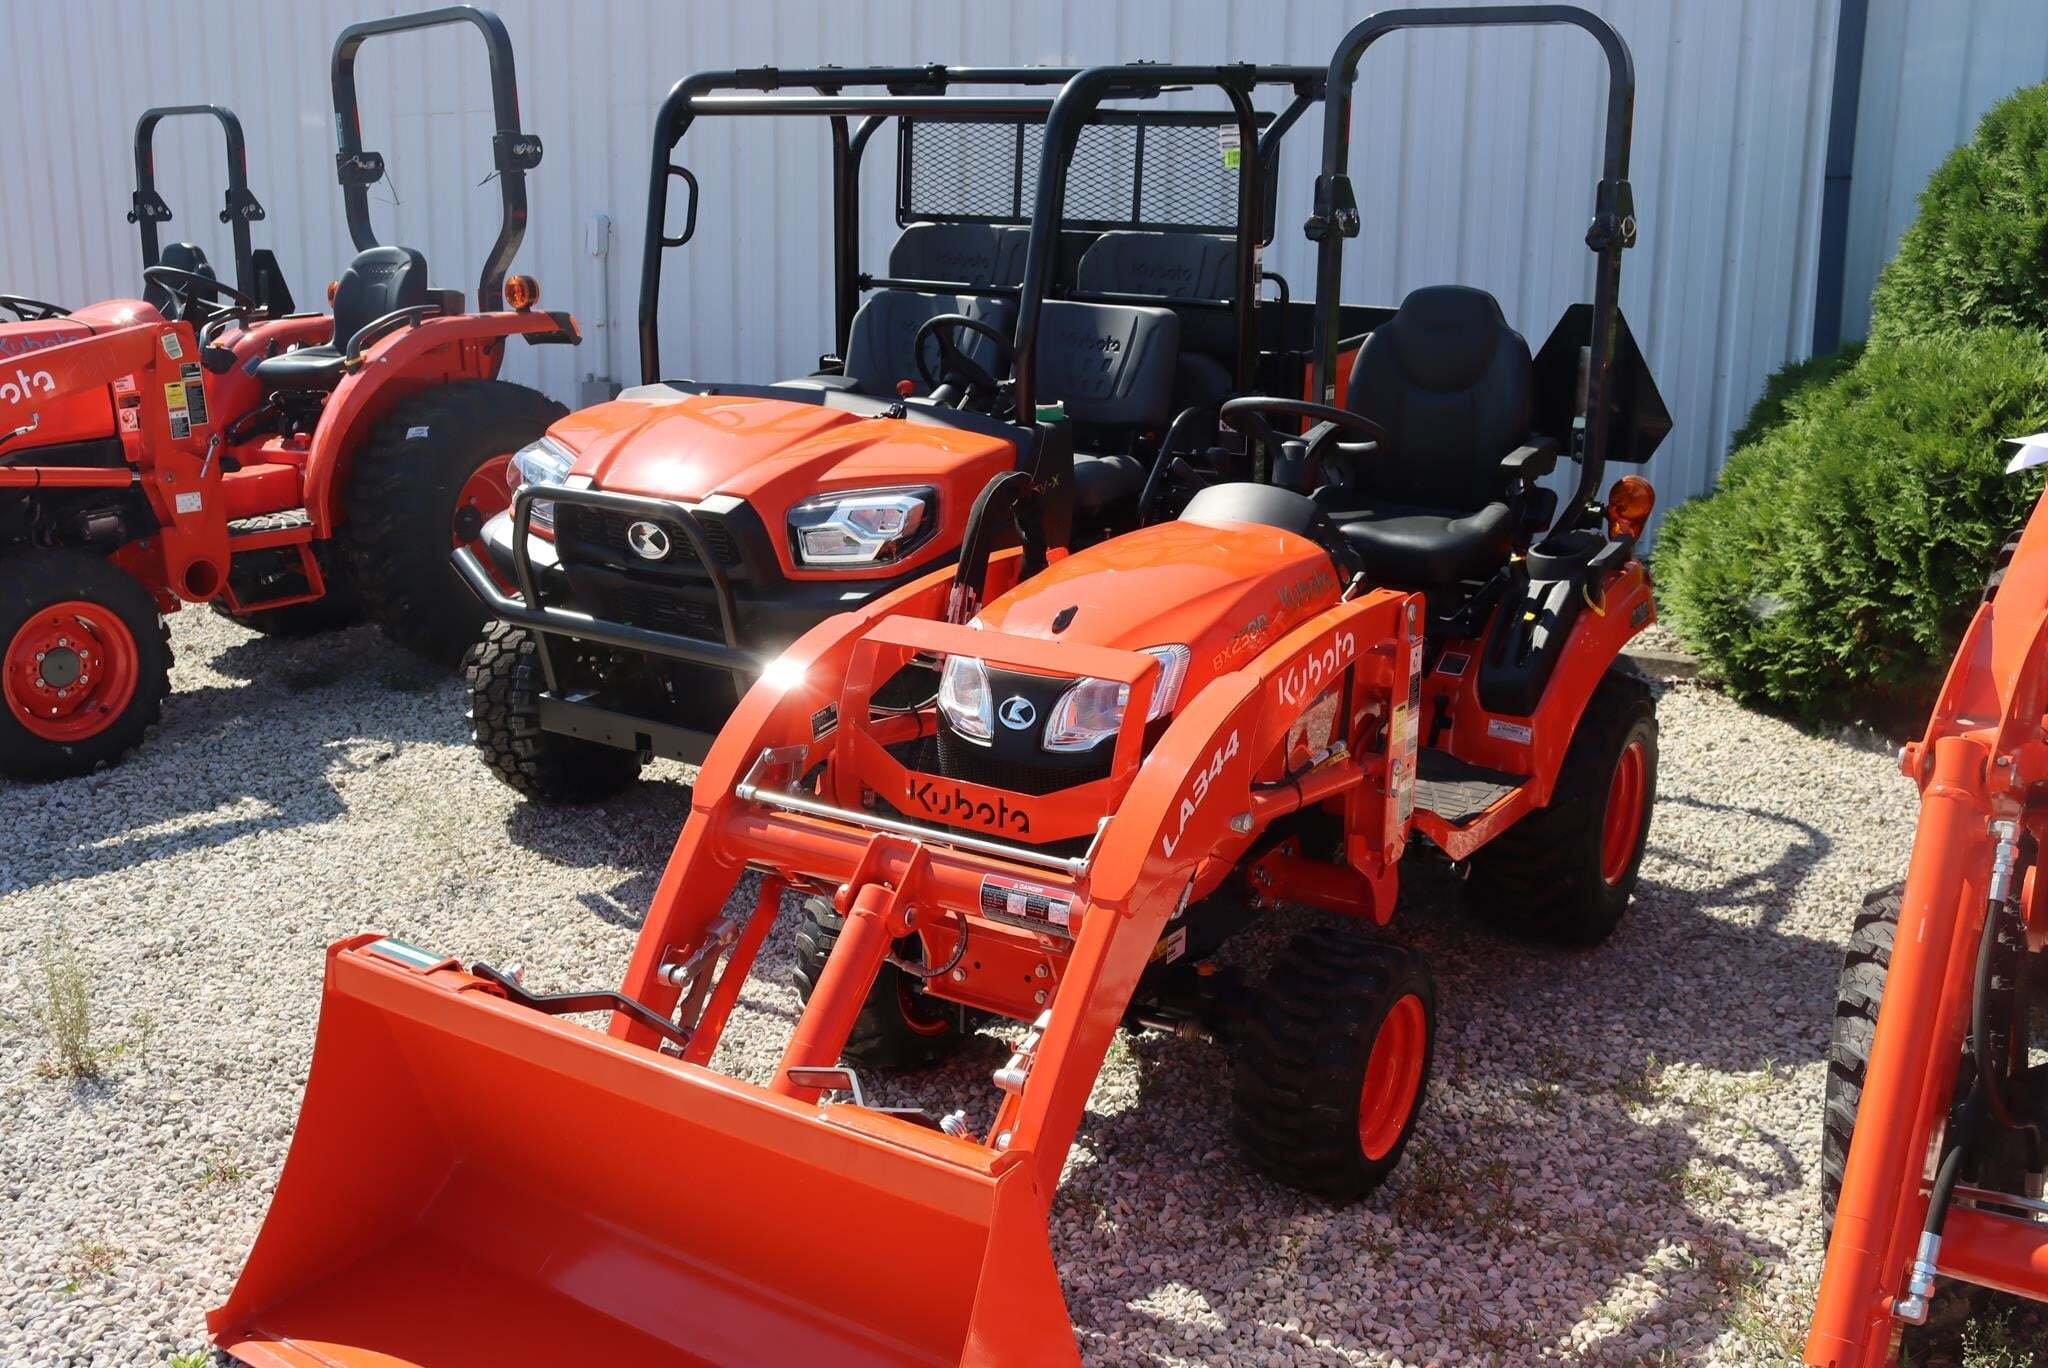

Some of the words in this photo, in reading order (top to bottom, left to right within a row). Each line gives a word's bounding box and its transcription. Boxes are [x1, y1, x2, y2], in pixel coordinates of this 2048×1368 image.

[1278, 631, 1355, 706] Kubota
[909, 778, 1031, 834] Kubota
[1162, 728, 1240, 859] LA344
